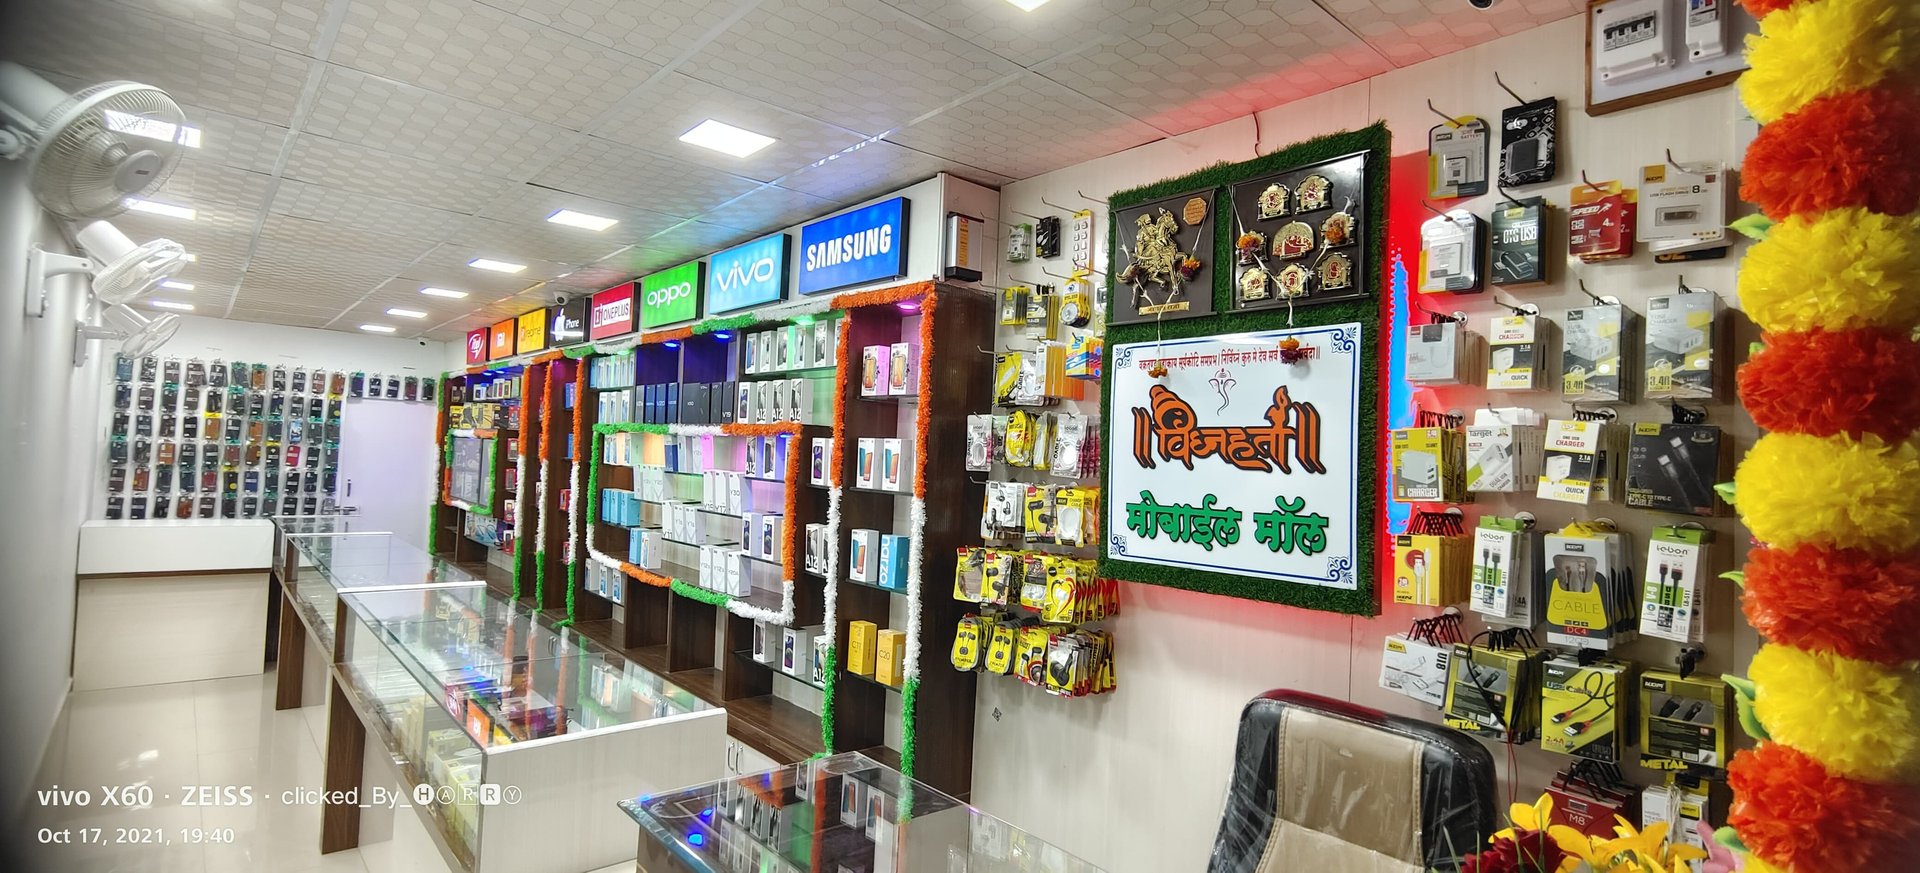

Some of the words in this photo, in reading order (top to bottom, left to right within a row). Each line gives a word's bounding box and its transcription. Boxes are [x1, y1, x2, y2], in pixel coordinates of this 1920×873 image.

[1503, 229, 1519, 244] OTG
[1520, 226, 1537, 241] USB
[806, 223, 892, 272] SAMSUNG
[647, 281, 692, 308] oppo
[602, 302, 629, 322] ONEPLUS
[565, 318, 580, 330] iPhone
[756, 408, 767, 421] A12
[772, 408, 784, 421] A12
[789, 408, 801, 421] A12
[1469, 429, 1493, 438] Target
[1555, 439, 1585, 448] CHARGER
[1407, 488, 1438, 498] CHARGER
[1565, 486, 1585, 494] QUICK
[1126, 490, 1243, 551] मोबाईल
[1253, 496, 1329, 556] मॉल
[806, 554, 818, 569] A12
[880, 536, 890, 585] narzo
[1552, 599, 1600, 614] CABLE
[1566, 626, 1587, 635] DC4
[879, 650, 891, 660] C20
[1435, 652, 1448, 671] U18
[1444, 718, 1481, 731] METAL
[1640, 759, 1688, 770] METAL
[1569, 814, 1586, 825] M8
